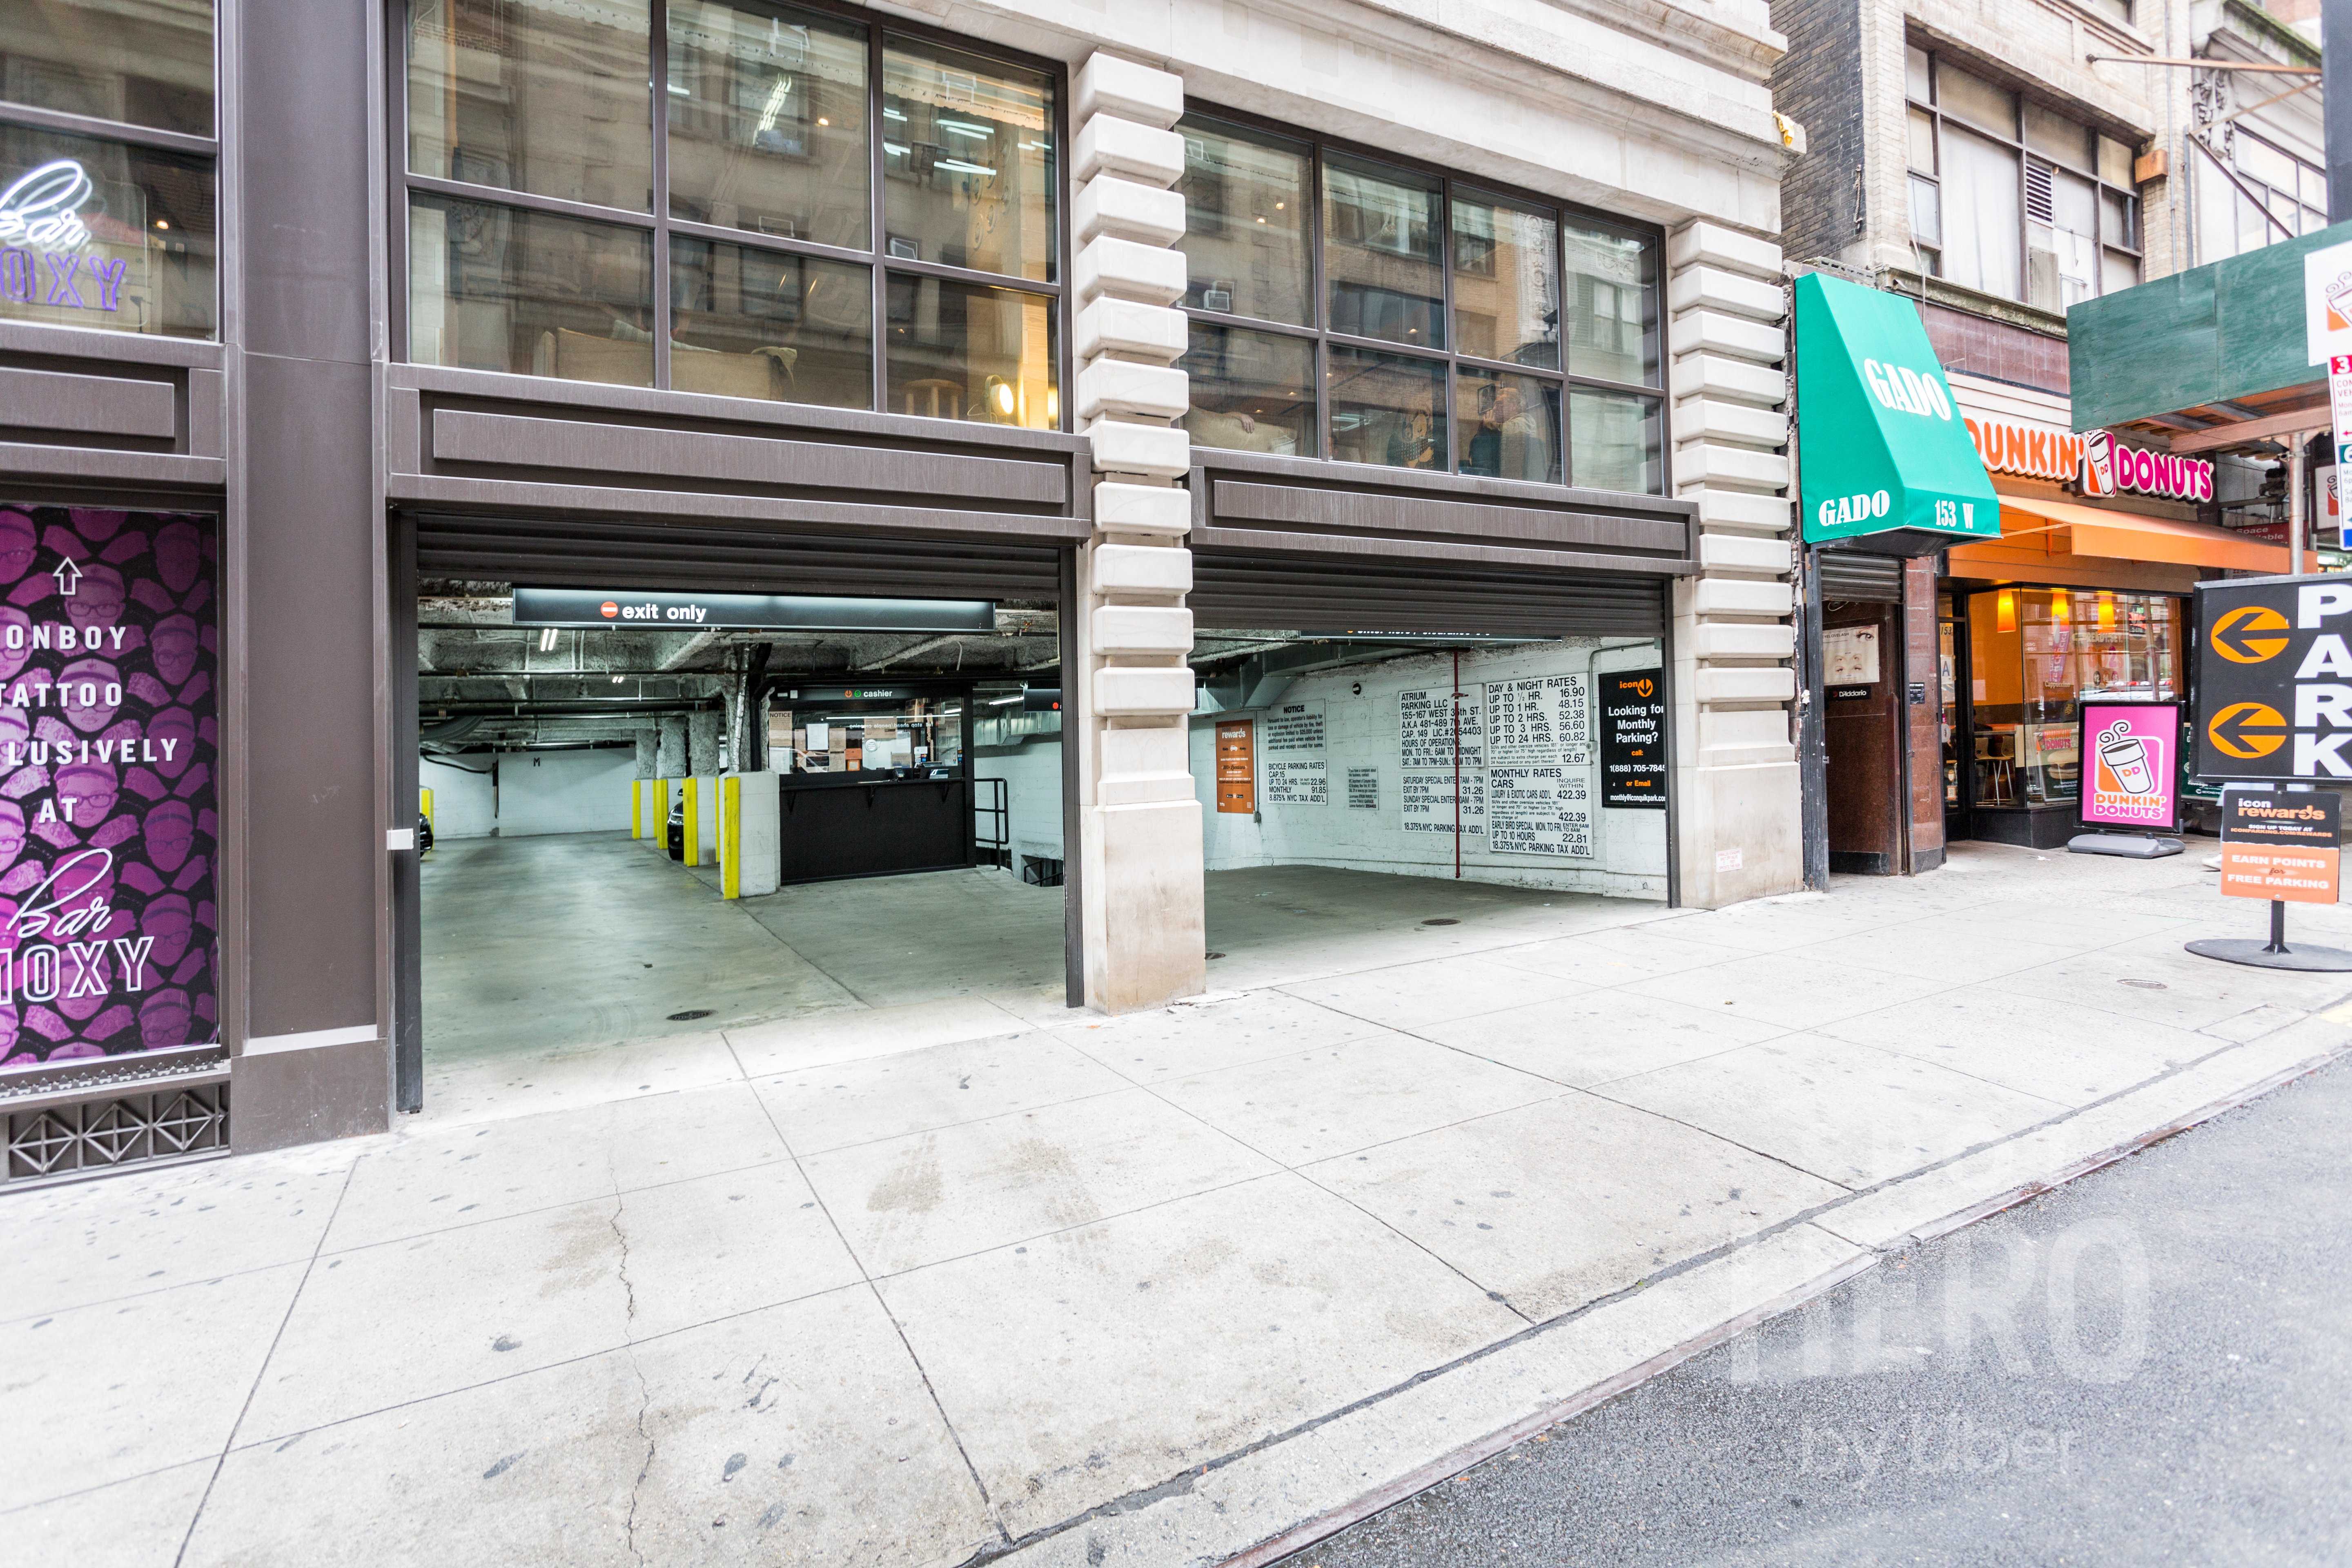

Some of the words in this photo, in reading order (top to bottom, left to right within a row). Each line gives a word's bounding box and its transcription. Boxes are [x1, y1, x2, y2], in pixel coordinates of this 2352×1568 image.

[2336, 356, 2350, 374] 3
[1864, 358, 1951, 421] GADO
[2118, 447, 2213, 500] DONUTS
[1818, 490, 1890, 527] GADO
[1934, 499, 1958, 527] 153
[1962, 502, 1974, 529] W
[622, 603, 659, 619] exit
[667, 604, 706, 623] only
[1941, 627, 1952, 635] 153
[1942, 661, 1950, 676] A
[1489, 684, 1503, 693] DAY
[1508, 683, 1513, 692] &
[1517, 680, 1543, 691] NIGHT
[1547, 677, 1576, 688] RATES
[1401, 691, 1426, 701] ATRIUM
[1559, 687, 1585, 697] 16.90
[1284, 705, 1305, 713] NOTICE
[1401, 701, 1431, 710] PARKING
[1434, 699, 1448, 708] LLC
[1490, 705, 1500, 714] UP
[1503, 704, 1514, 713] TO
[1518, 704, 1521, 712] 1
[1525, 702, 1539, 711] HR.
[1559, 699, 1584, 708] 48.15
[1402, 710, 1426, 719] 155-167
[1429, 709, 1448, 718] WEST
[1470, 706, 1481, 715] ST.
[1559, 710, 1584, 720] 52.38
[1608, 705, 1646, 717] Looking
[1402, 721, 1417, 729] A.K.A
[1420, 719, 1447, 728] 481-489
[1463, 717, 1478, 726] AVE.
[1559, 721, 1584, 731] 56.60
[1617, 719, 1656, 730] Monthly
[1222, 728, 1245, 738] rewards
[1402, 730, 1415, 738] CAP.
[1417, 729, 1428, 738] 149
[1559, 732, 1585, 742] 60.82
[1616, 732, 1658, 744] Parking?
[1402, 739, 1418, 747] HOURS
[1402, 748, 1414, 757] MON.
[534, 757, 540, 766] M
[1465, 757, 1470, 765] TO
[1473, 757, 1481, 765] 7PM
[1562, 753, 1585, 763] 12.67
[1491, 769, 1529, 778] MONTHLY
[1533, 768, 1561, 777] RATES
[1610, 764, 1631, 773] 1(888)
[2122, 767, 2140, 777] DD
[1492, 780, 1514, 788] CARS
[1557, 790, 1586, 800] 422.39
[2096, 795, 2165, 806] DUNKIN'
[2238, 798, 2271, 808] icon
[38, 797, 77, 823] AT
[2095, 805, 2161, 817] DONUTS
[2238, 805, 2325, 820] rewards
[1492, 821, 1504, 829] EARLY
[1506, 821, 1515, 830] BIRD
[1516, 822, 1533, 830] SPECIAL
[1562, 833, 1586, 843] 22.81
[2232, 855, 2269, 865] EARN
[2273, 858, 2326, 869] POINTS
[2227, 874, 2262, 884] FREE
[2265, 877, 2329, 889] PARKING
[6, 848, 113, 938] Bar
